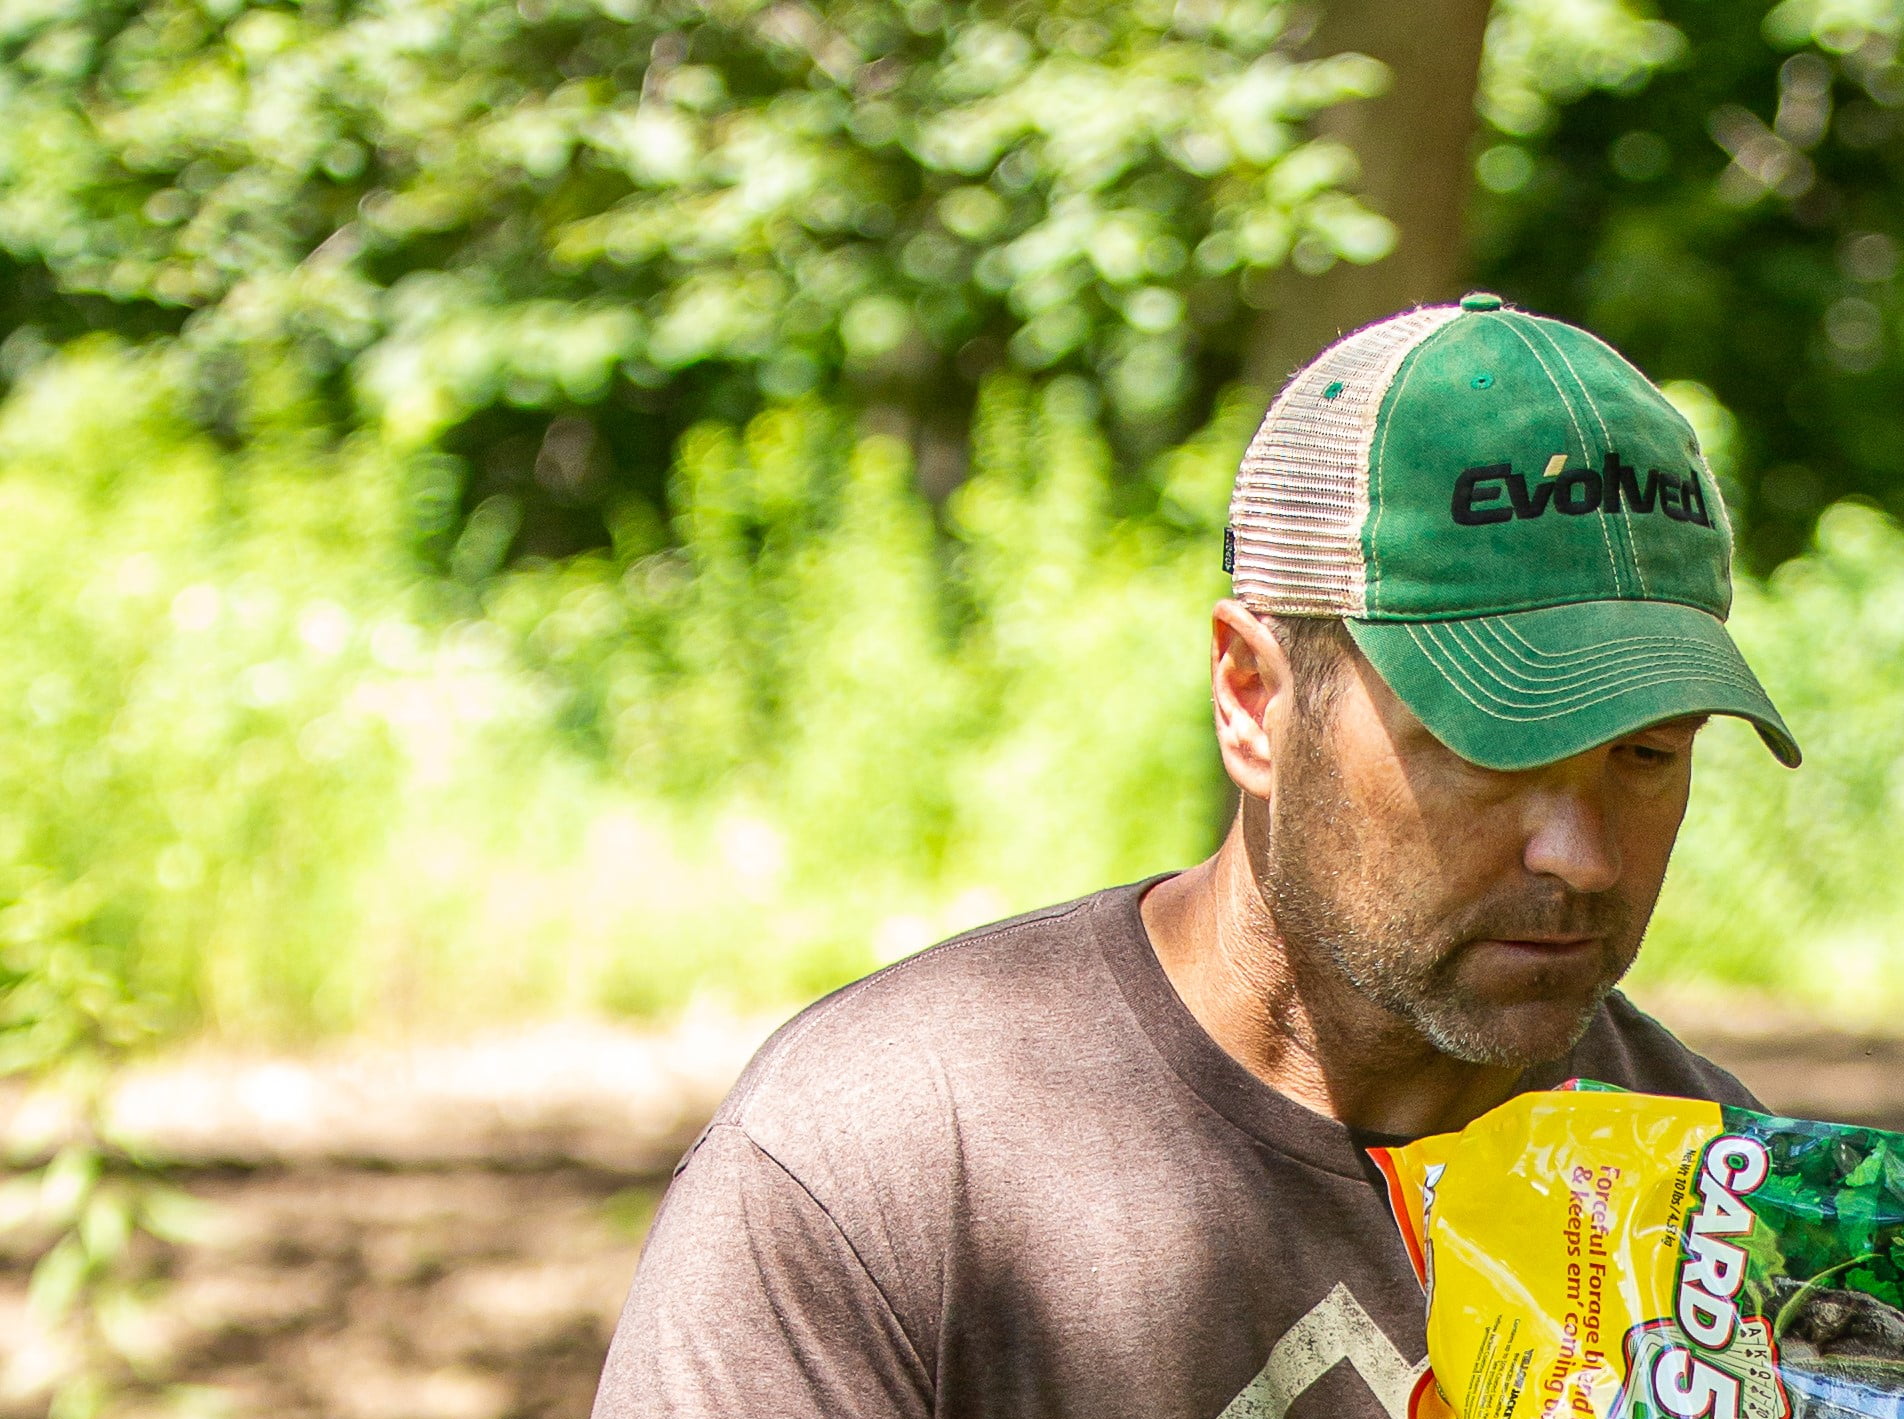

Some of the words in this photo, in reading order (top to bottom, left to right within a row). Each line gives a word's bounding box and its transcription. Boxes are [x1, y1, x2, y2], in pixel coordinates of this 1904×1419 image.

[1451, 452, 1716, 529] Evolved
[1571, 1165, 1593, 1184] &
[1675, 1176, 1687, 1191] 10
[1670, 1191, 1685, 1206] lbs
[1588, 1165, 1621, 1257] Forceful
[1563, 1189, 1590, 1257] keeps
[1661, 1235, 1676, 1248] kg
[1675, 1137, 1769, 1349] CARD
[1582, 1262, 1607, 1344] Forage
[1748, 1327, 1762, 1337] A
[1543, 1311, 1579, 1394] coming
[1754, 1350, 1768, 1359] K
[1757, 1371, 1771, 1380] Q
